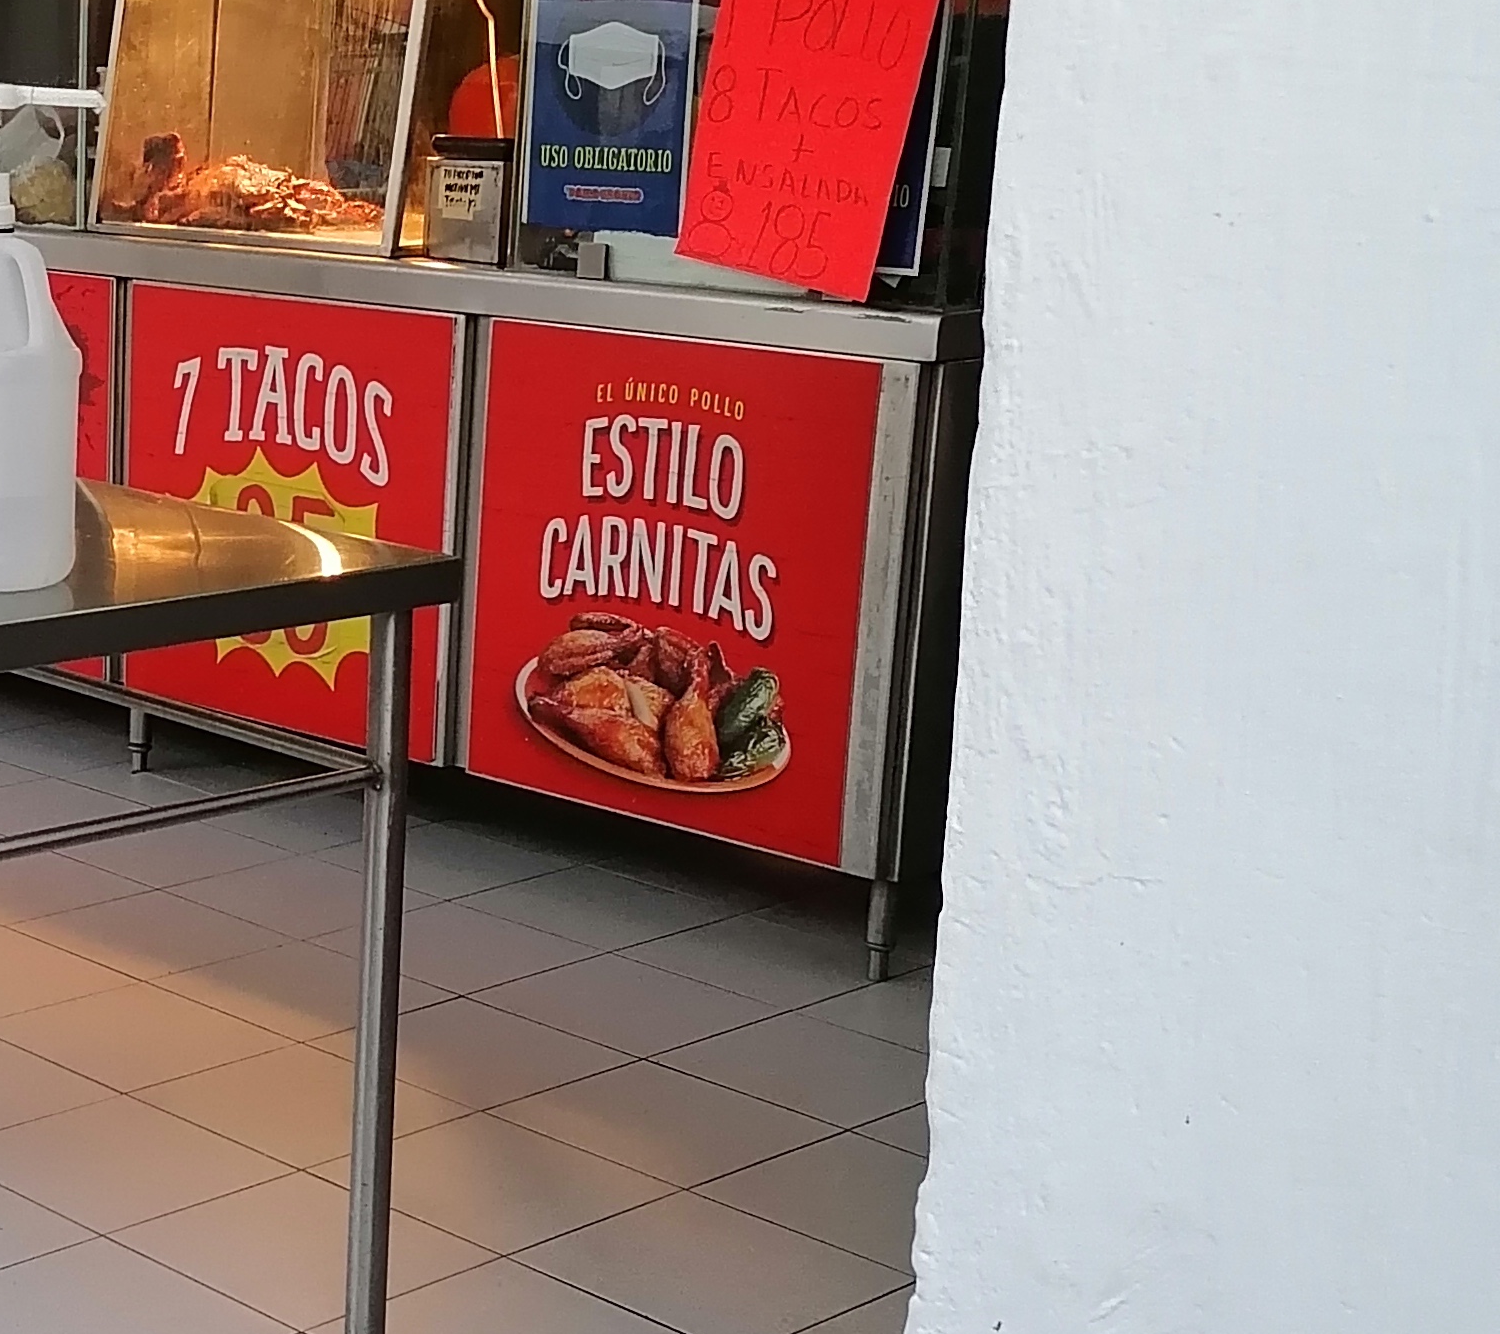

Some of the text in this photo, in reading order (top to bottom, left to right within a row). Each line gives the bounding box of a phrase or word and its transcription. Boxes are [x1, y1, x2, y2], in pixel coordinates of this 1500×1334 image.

[706, 63, 882, 131] 8 TACOS
[540, 144, 673, 173] USO OBLIGATORIO
[707, 151, 869, 207] ENSALADA
[173, 344, 393, 488] 7 TACOS
[596, 377, 745, 421] EL ÚNICO POLLO
[581, 414, 744, 520] ESTILO
[539, 514, 778, 641] CARNITAS
